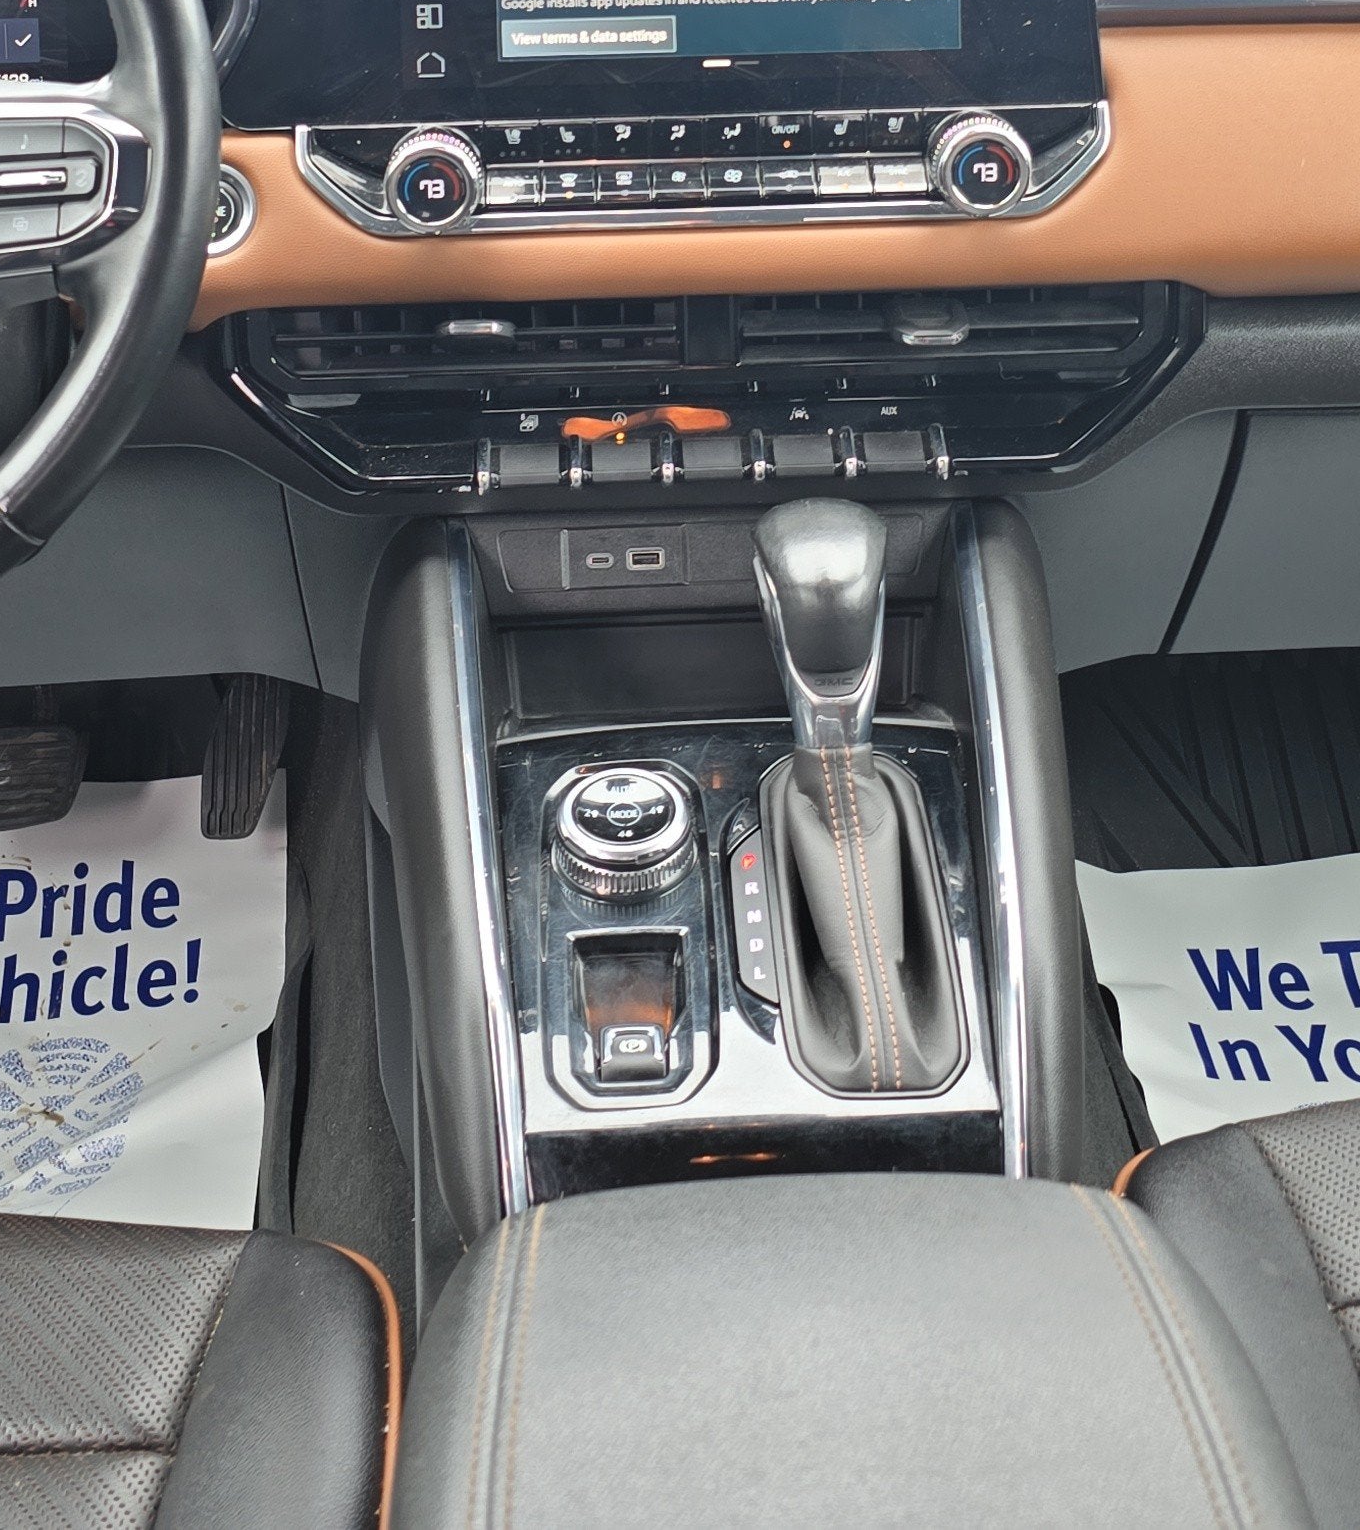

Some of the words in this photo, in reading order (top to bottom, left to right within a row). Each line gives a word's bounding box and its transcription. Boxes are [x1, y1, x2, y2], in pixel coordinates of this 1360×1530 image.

[510, 33, 541, 45] View
[542, 32, 578, 45] terms
[579, 31, 589, 44] &
[591, 30, 619, 43] data
[619, 29, 668, 44] settings
[771, 124, 800, 135] ON/OFF
[973, 162, 999, 183] 73
[419, 179, 446, 200] 73
[880, 406, 898, 417] AUX
[610, 809, 638, 820] MODE
[744, 881, 759, 896] R
[746, 909, 762, 924] N
[749, 938, 764, 953] D
[753, 966, 766, 980] L
[1186, 946, 1314, 1013] We
[1186, 1022, 1272, 1083] In
